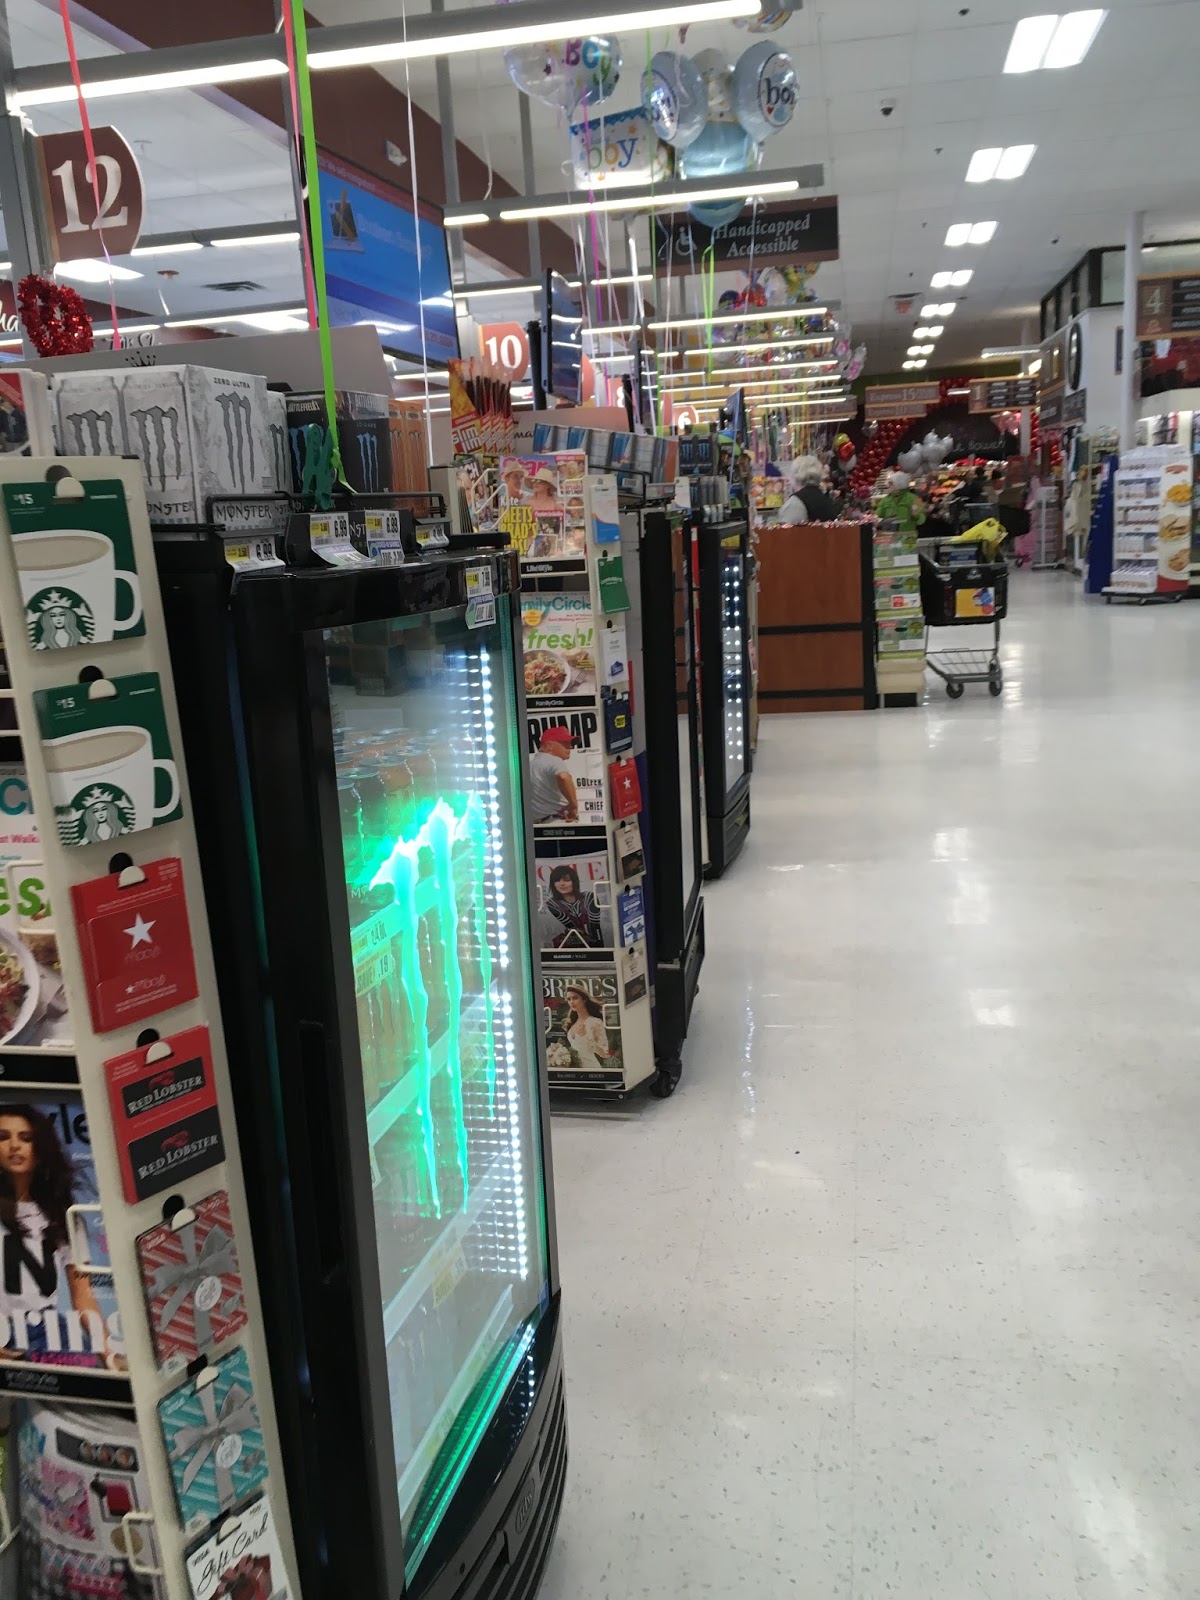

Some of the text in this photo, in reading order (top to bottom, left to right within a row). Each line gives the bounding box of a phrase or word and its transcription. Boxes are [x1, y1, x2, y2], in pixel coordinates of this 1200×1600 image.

[52, 155, 129, 234] 12
[715, 213, 811, 240] Handicapped
[726, 235, 799, 258] Accessible
[485, 334, 523, 369] 10
[213, 376, 251, 389] ZERO ULTRA
[902, 388, 915, 401] 15
[677, 414, 690, 430] 6
[147, 501, 196, 516] ONSTER
[215, 500, 272, 522] MONSTER
[501, 506, 533, 523] MEETS
[528, 627, 594, 650] fresh!
[528, 712, 598, 754] RUMP
[595, 789, 603, 799] IN
[584, 801, 604, 811] CHIEF
[127, 1075, 202, 1115] RED LOBSTER
[138, 1134, 219, 1180] RED LOBSTER
[232, 1511, 269, 1559] Card
[197, 1549, 231, 1597] Gift
